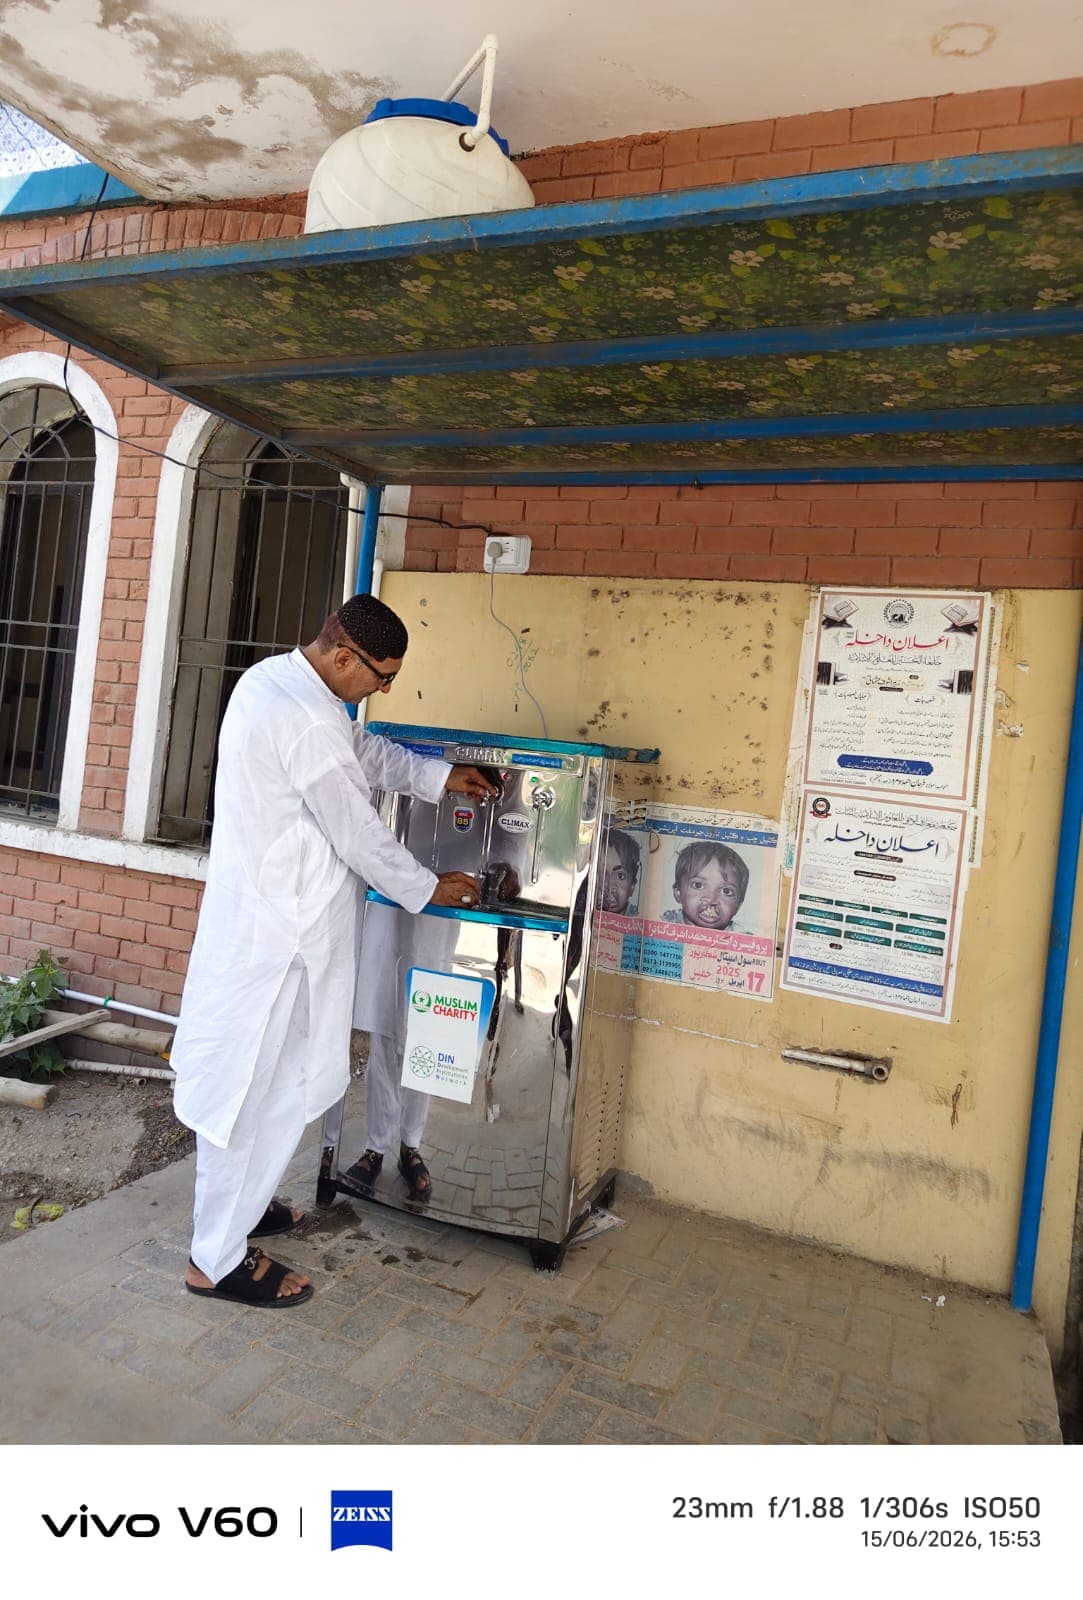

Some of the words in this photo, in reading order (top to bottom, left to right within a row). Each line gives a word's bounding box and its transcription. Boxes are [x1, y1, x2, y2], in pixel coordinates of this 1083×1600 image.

[845, 629, 892, 648] داخلہ
[893, 634, 949, 651] اعلان
[455, 746, 508, 764] CLIMAX
[501, 818, 530, 829] CLIMAX
[824, 823, 875, 847] داخلہ
[876, 834, 939, 857] اعلان
[717, 966, 741, 977] 2025
[747, 971, 765, 993] 17
[434, 995, 478, 1012] MUSLIM
[433, 1005, 478, 1021] CHARITY
[437, 1053, 455, 1065] DIN
